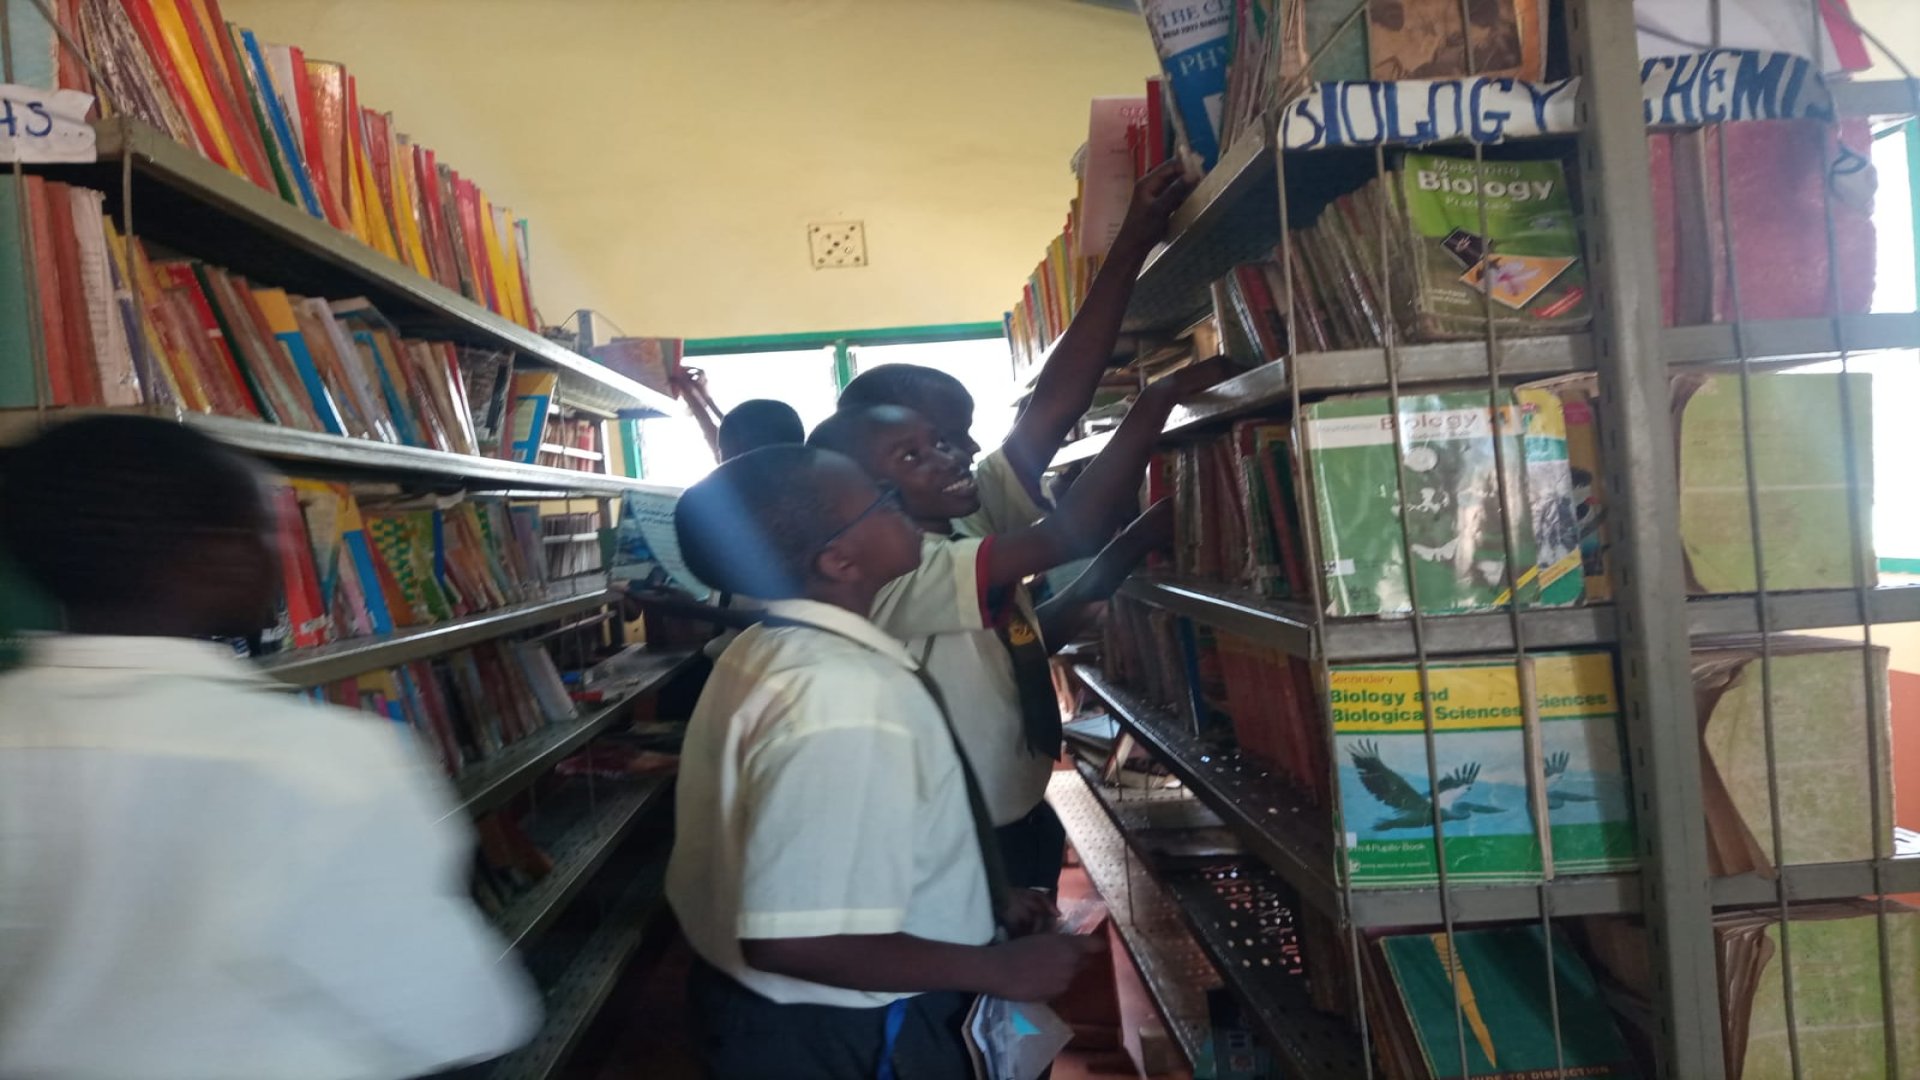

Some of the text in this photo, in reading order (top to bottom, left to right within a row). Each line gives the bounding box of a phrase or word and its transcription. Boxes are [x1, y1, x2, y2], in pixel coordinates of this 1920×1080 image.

[1282, 77, 1575, 149] BIOLOGY
[1417, 170, 1554, 201] Biology
[1380, 412, 1477, 430] Bology
[1331, 690, 1405, 706] Biology
[1332, 705, 1523, 724] Biologica Sciences
